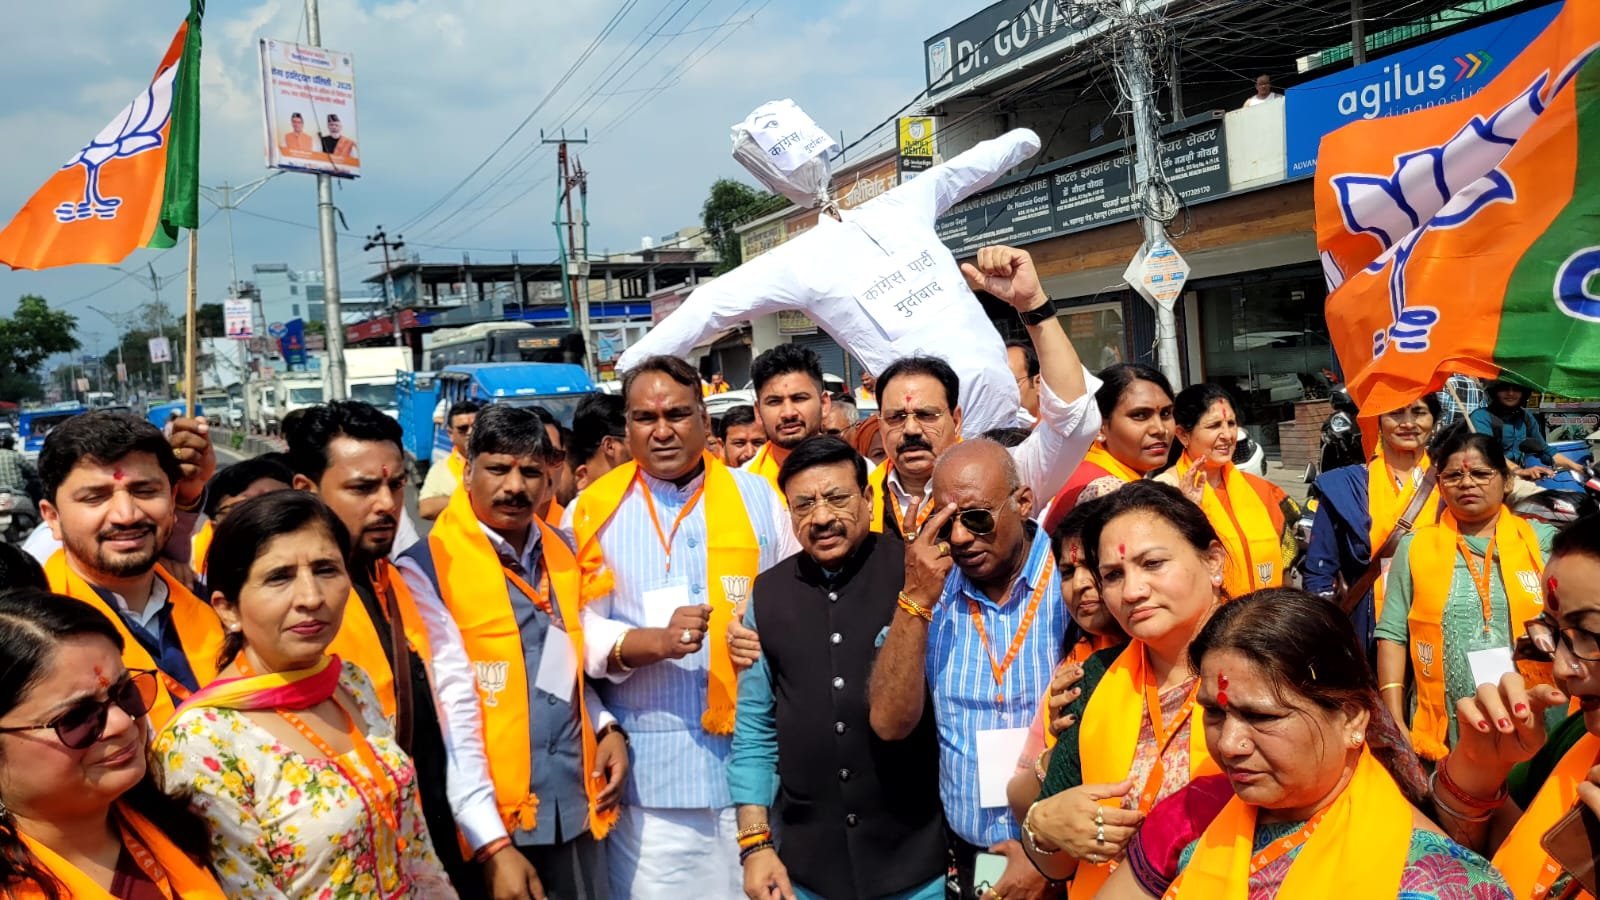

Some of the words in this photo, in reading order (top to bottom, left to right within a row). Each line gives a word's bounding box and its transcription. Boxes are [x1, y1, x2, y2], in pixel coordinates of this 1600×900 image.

[958, 39, 989, 76] Dr.
[1338, 63, 1446, 120] agilus
[768, 131, 801, 156] कांग्रेस
[1186, 128, 1217, 147] सेन्टर
[1020, 179, 1048, 195] CENTRE
[862, 270, 906, 300] कांग्रेस
[907, 249, 936, 272] पार्टी
[893, 281, 944, 318] मुर्दाबाद
